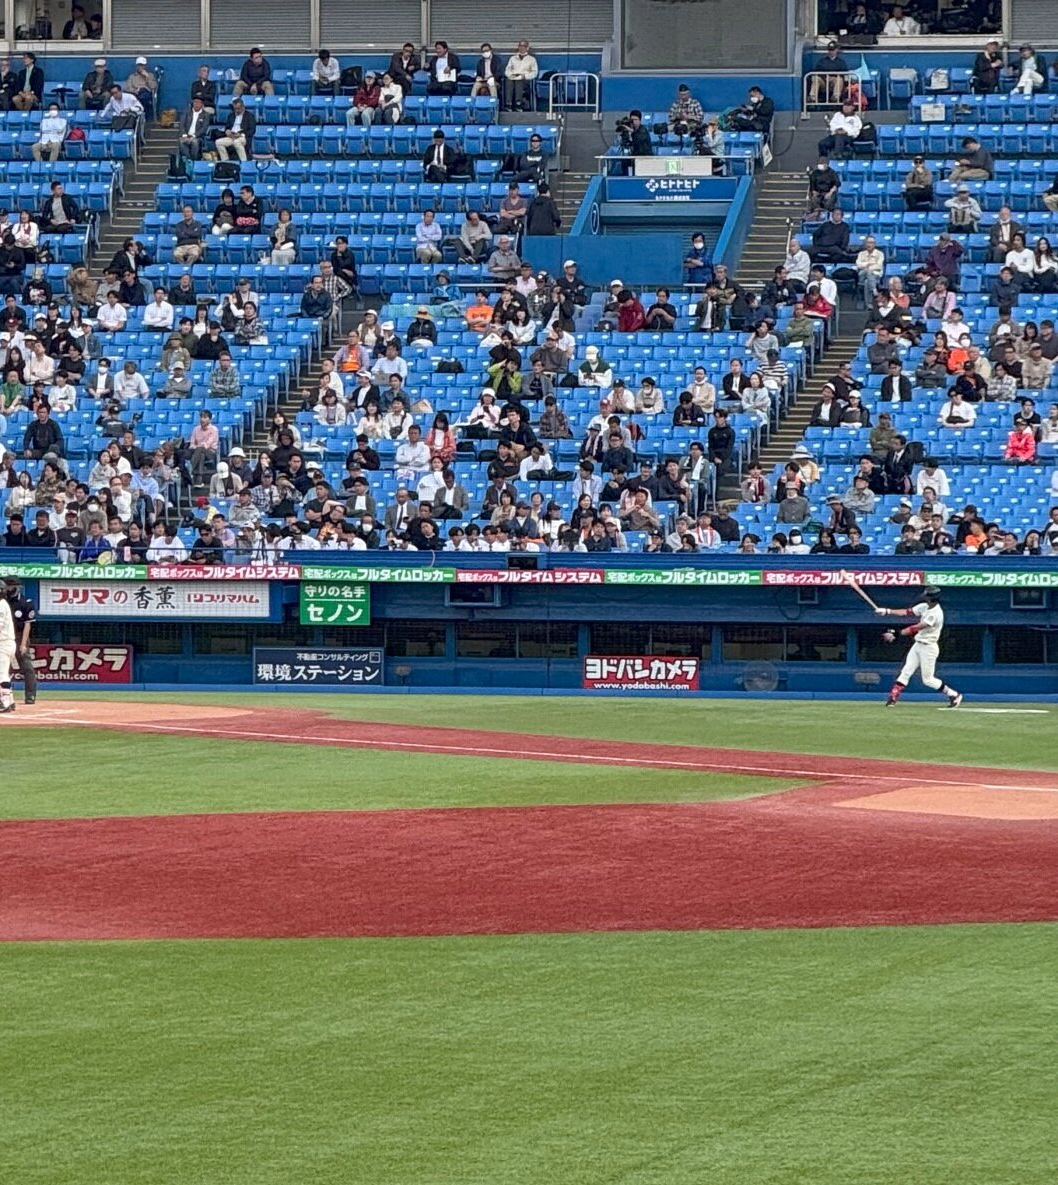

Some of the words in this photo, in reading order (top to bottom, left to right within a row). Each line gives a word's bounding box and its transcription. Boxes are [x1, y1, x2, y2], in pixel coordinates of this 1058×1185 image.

[305, 585, 366, 598] 守りの名手
[307, 603, 363, 622] セノン
[257, 664, 379, 681] 環境ステーション
[586, 658, 696, 680] ヨドバシカメラ
[594, 681, 690, 691] www.yodobashi.com
